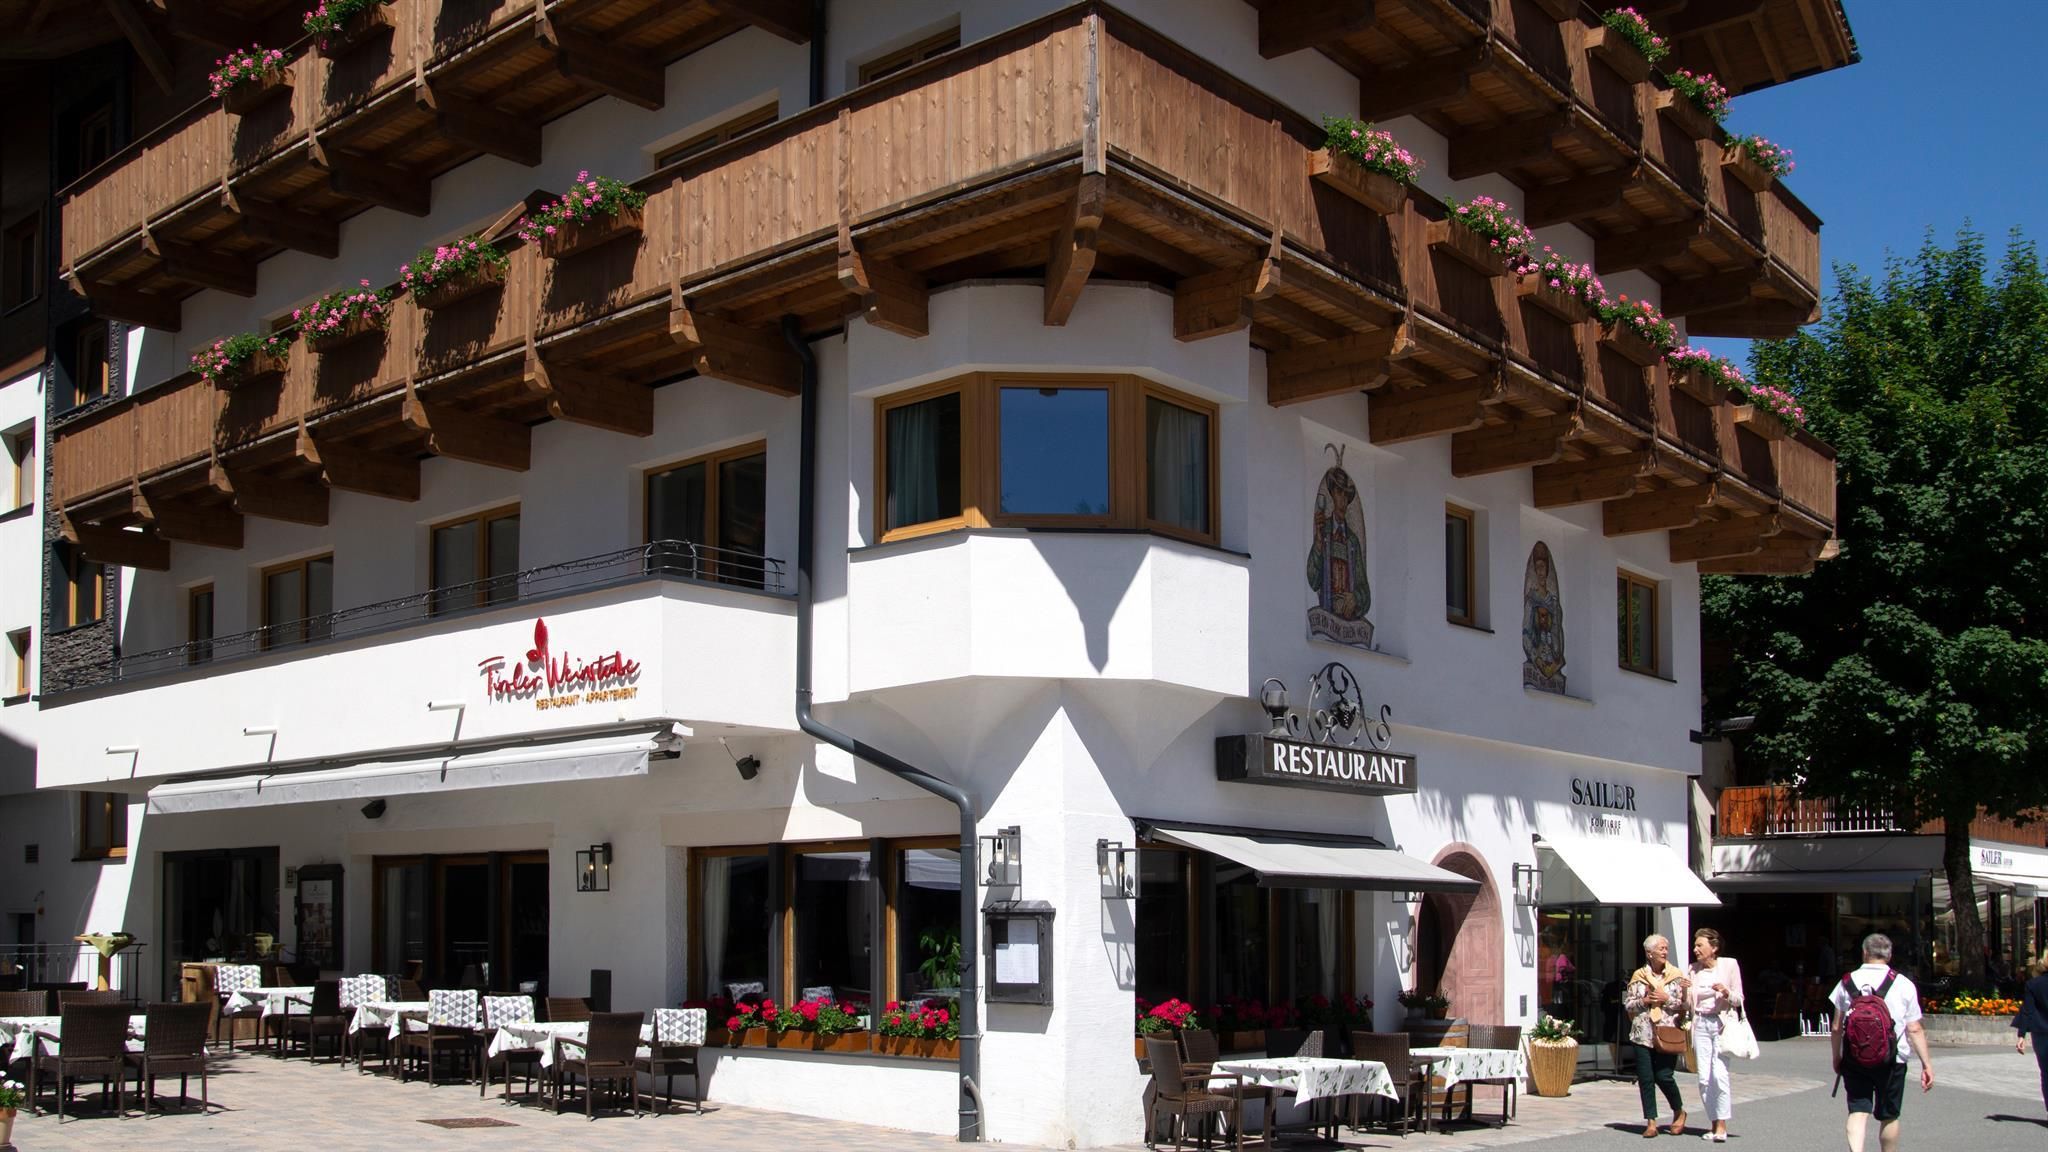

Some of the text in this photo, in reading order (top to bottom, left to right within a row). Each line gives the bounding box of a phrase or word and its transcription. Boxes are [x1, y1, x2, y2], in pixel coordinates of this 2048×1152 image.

[536, 687, 639, 711] RESTAURANT APPARTEMENT
[1273, 742, 1407, 785] RESTAURANT
[1571, 777, 1636, 811] SAILER
